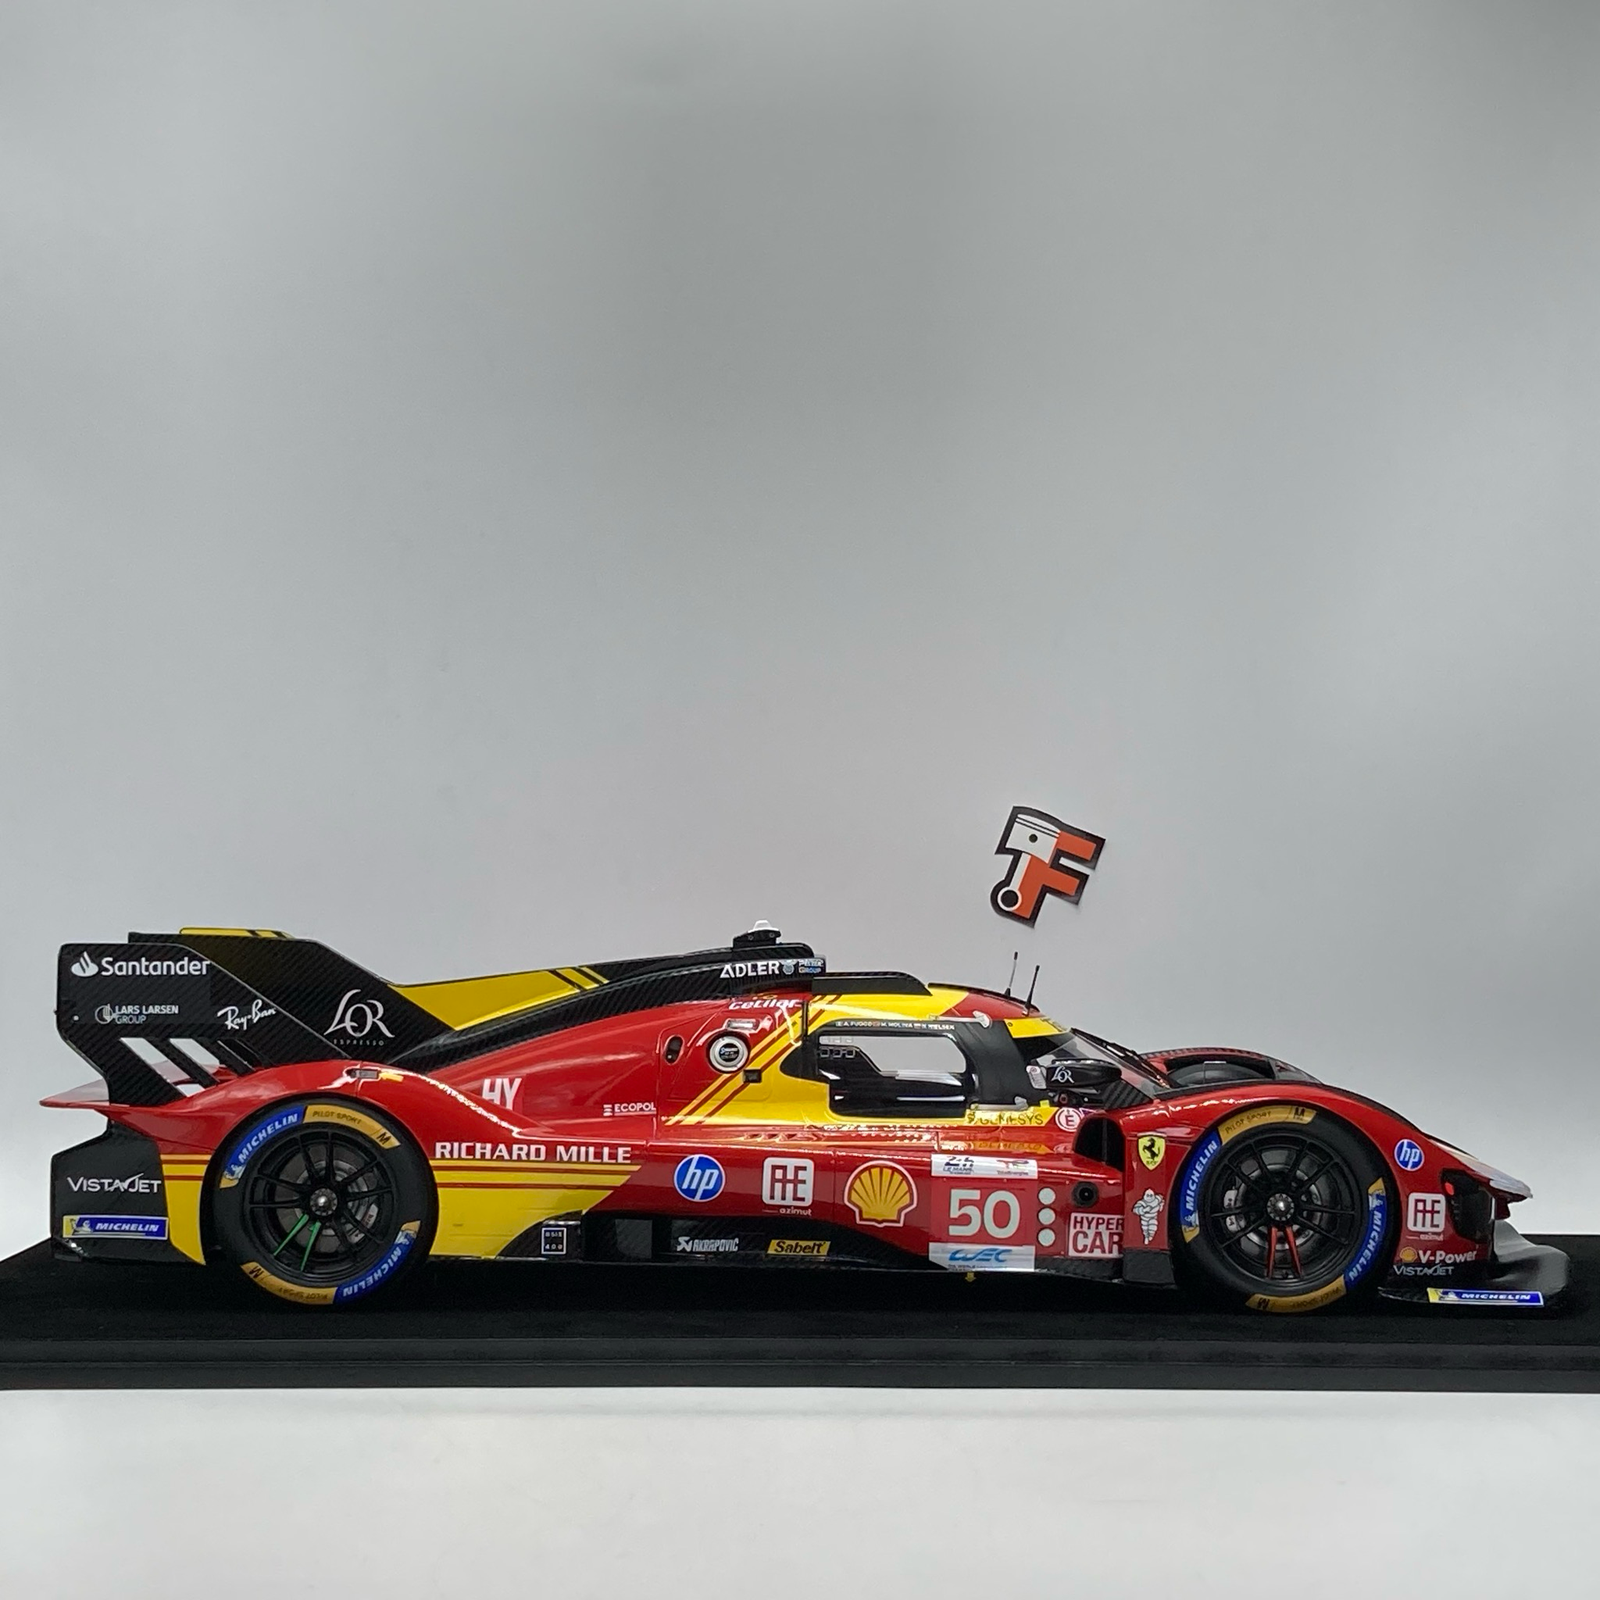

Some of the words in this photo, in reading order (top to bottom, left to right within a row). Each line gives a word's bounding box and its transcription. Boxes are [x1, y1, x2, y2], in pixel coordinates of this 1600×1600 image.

[101, 957, 210, 976] Santander
[720, 961, 780, 978] ADLER
[115, 1005, 140, 1014] LARS
[142, 1005, 179, 1014] LARSEN
[217, 999, 276, 1031] Ray-Ban
[115, 1015, 147, 1024] GROUP
[482, 1078, 522, 1111] HY
[614, 1102, 656, 1112] ECOPOL
[312, 1110, 336, 1118] PILOT
[336, 1112, 362, 1125] SPORT
[238, 1113, 298, 1163] MICHELIN
[376, 1132, 392, 1145] M
[435, 1141, 546, 1161] RICHARD
[556, 1145, 632, 1163] MILLE
[1400, 1140, 1420, 1169] hp
[681, 1156, 719, 1200] hp
[1185, 1140, 1217, 1211] MICHELIN
[779, 1206, 812, 1216] azimut
[948, 1189, 1021, 1238] 50
[95, 1222, 160, 1232] MICHELIN
[1073, 1216, 1124, 1230] HYPER
[1072, 1230, 1124, 1254] CAR
[1419, 1232, 1444, 1241] azimut
[774, 1241, 825, 1254] Sabelt
[1348, 1210, 1382, 1282] MICHELIN
[948, 1248, 1013, 1262] WEC
[1418, 1250, 1477, 1264] V-Power
[343, 1247, 402, 1297] MICHELIN
